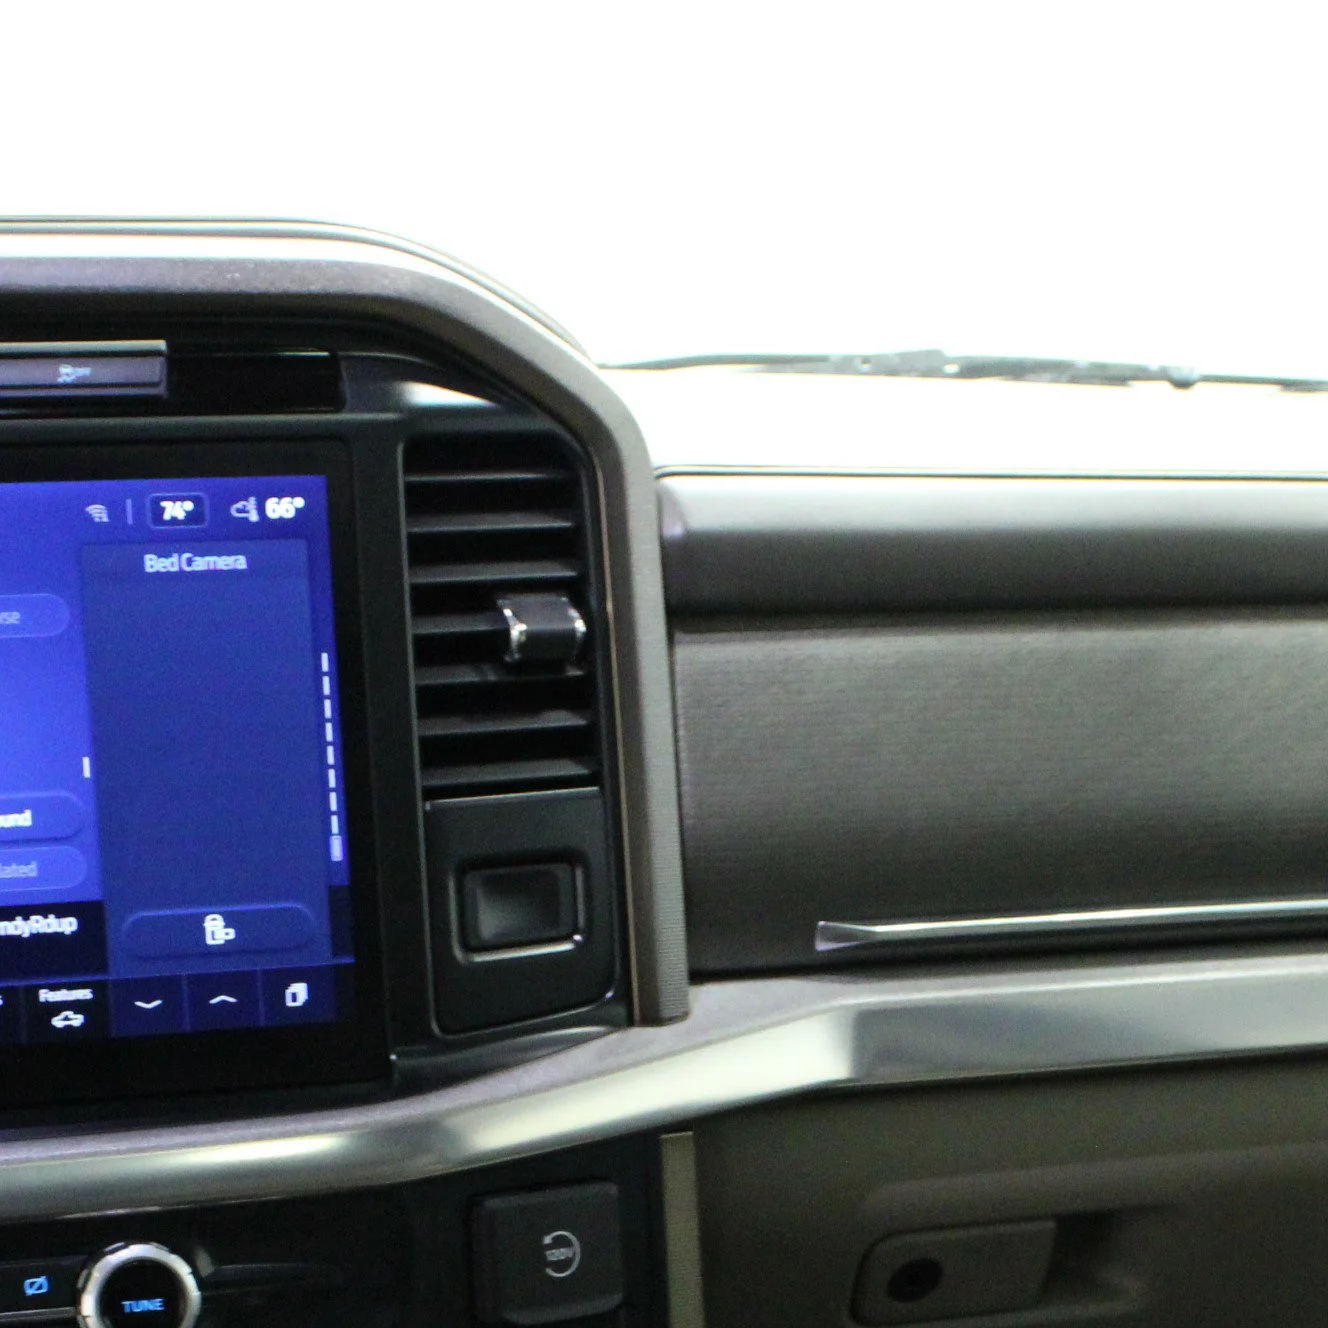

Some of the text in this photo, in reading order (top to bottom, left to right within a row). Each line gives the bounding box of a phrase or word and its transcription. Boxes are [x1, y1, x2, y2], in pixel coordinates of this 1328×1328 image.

[159, 501, 194, 521] 74°
[264, 497, 304, 520] 66°
[143, 553, 246, 574] Bed Camera
[38, 987, 93, 1003] Features
[122, 1298, 165, 1313] TUNE
